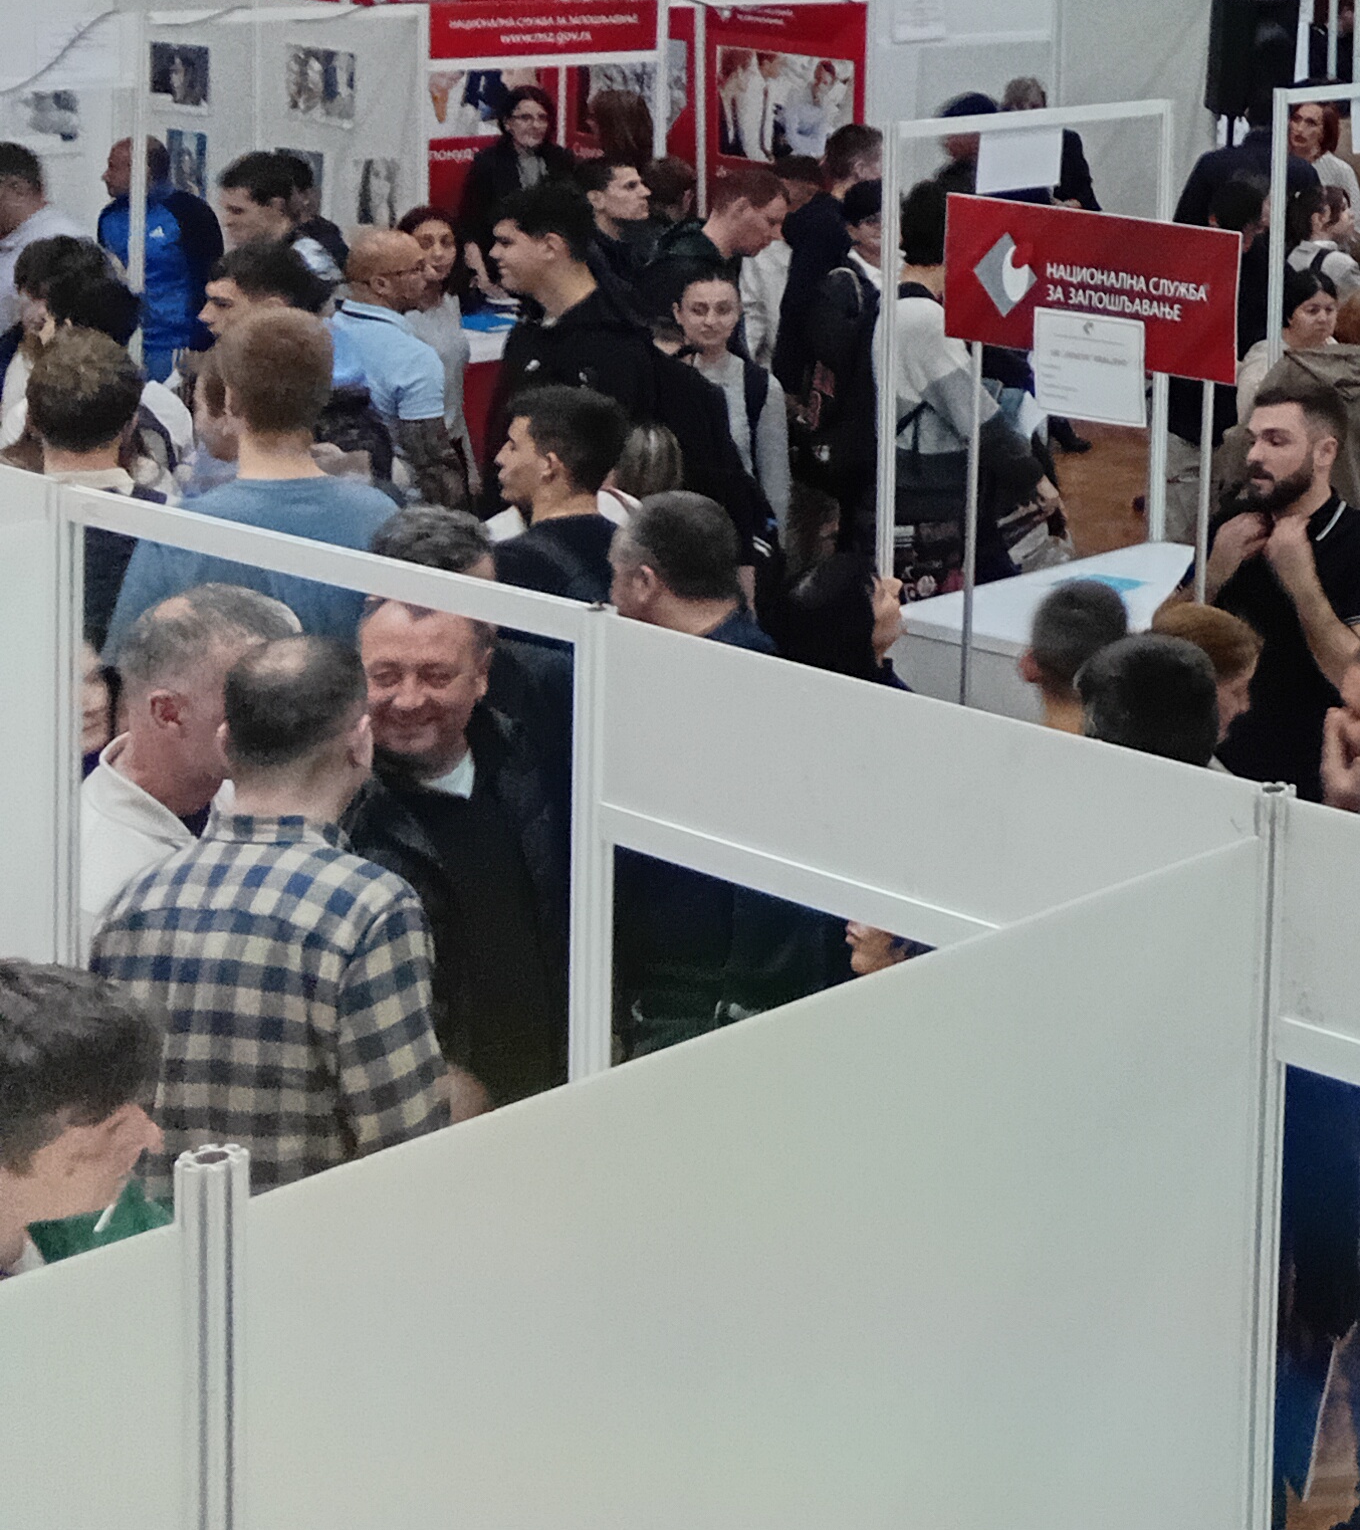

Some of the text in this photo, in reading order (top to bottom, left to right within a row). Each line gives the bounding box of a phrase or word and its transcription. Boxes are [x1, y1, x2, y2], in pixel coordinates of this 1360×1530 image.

[1046, 262, 1208, 302] НАЦИОНАЛНА СЛУЖБА
[1046, 284, 1182, 321] ЗА ЗАПОШЉАВАЊЕ
